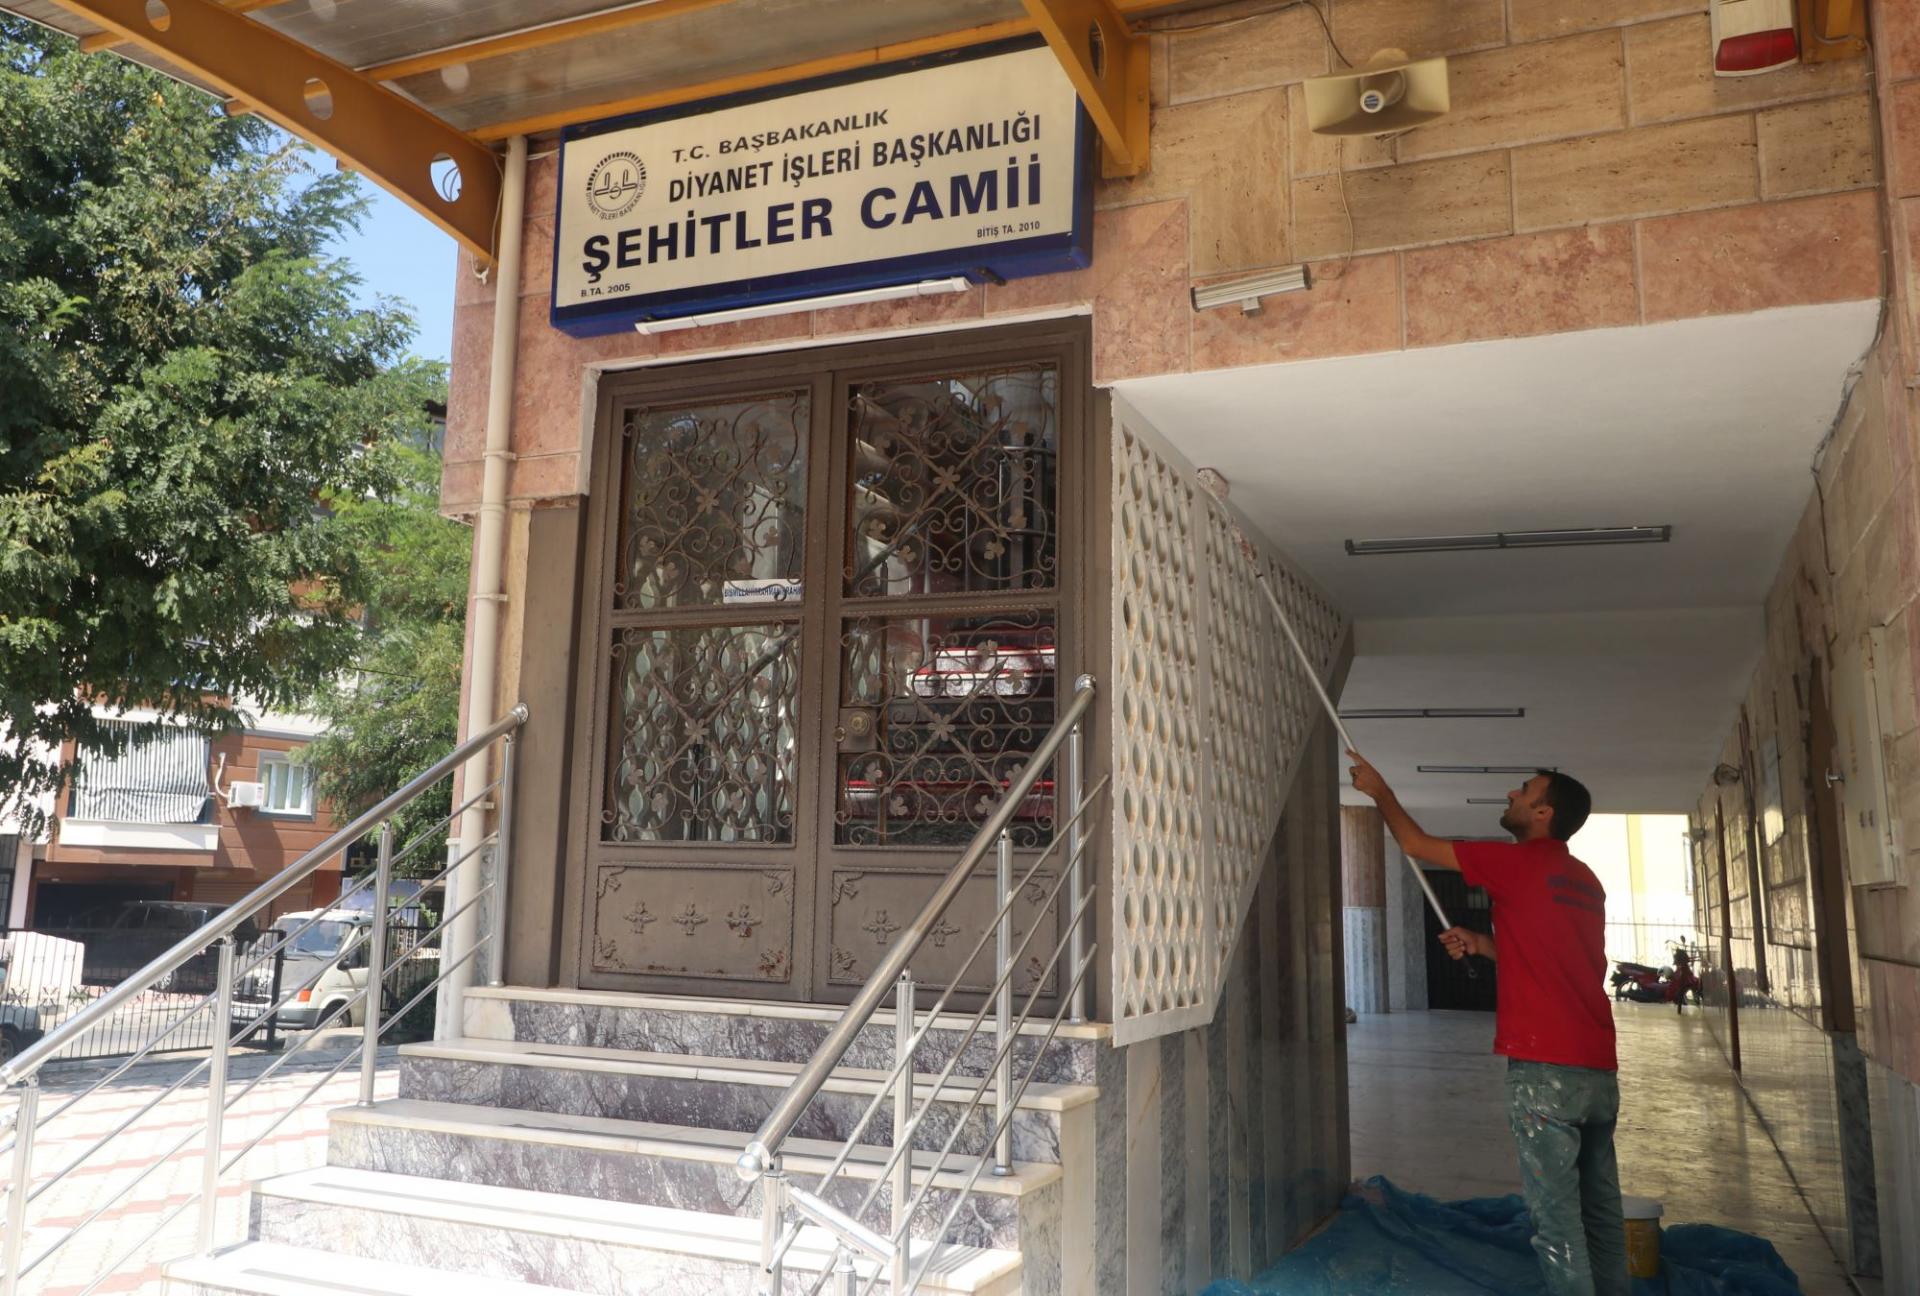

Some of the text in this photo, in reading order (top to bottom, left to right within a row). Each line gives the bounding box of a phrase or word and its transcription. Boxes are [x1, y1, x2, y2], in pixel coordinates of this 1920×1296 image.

[669, 110, 1040, 203] DİYANET İŞLERİ BAŞKANLIĞI
[672, 109, 888, 163] T.C. BAŞBAKANLIK
[582, 153, 1041, 284] ŞEHİTLER CAMİİ
[977, 225, 999, 238] BİTİŞ
[1019, 220, 1041, 232] 2010
[607, 283, 631, 294] 2005
